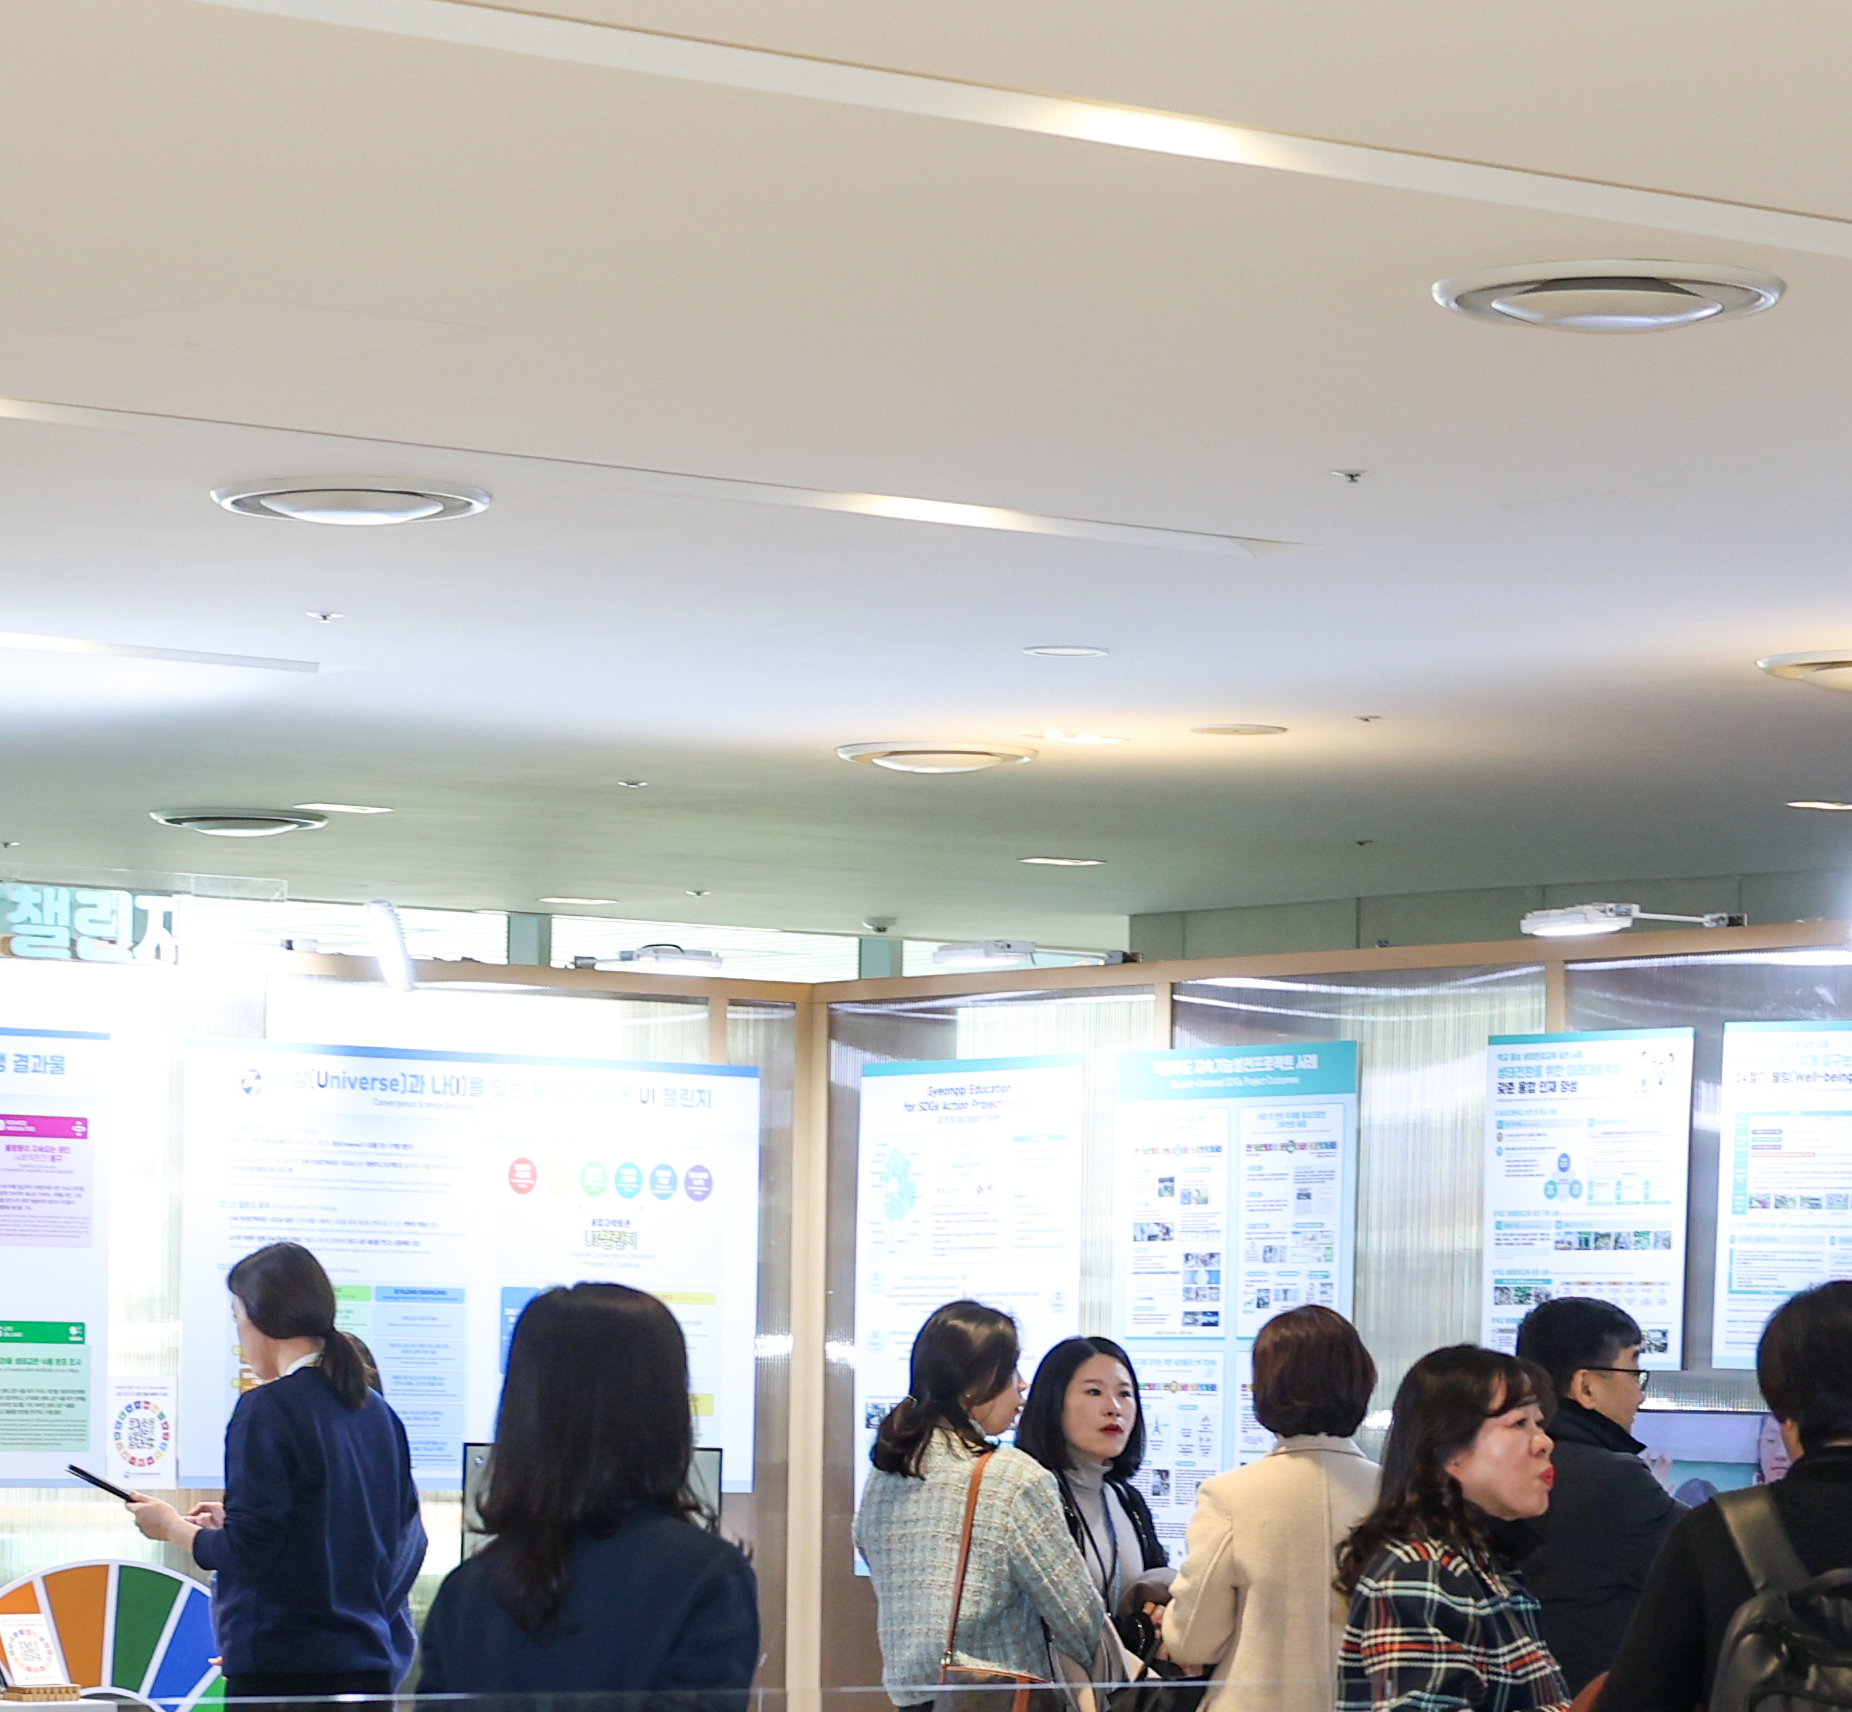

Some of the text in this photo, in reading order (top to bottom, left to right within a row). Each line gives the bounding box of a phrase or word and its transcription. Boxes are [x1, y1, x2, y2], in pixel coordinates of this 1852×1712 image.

[13, 1054, 66, 1075] 결과물
[275, 1068, 426, 1095] 상(Universe)과
[639, 1087, 656, 1104] UI
[662, 1087, 713, 1109] 챌린지
[969, 1084, 1011, 1095] Education
